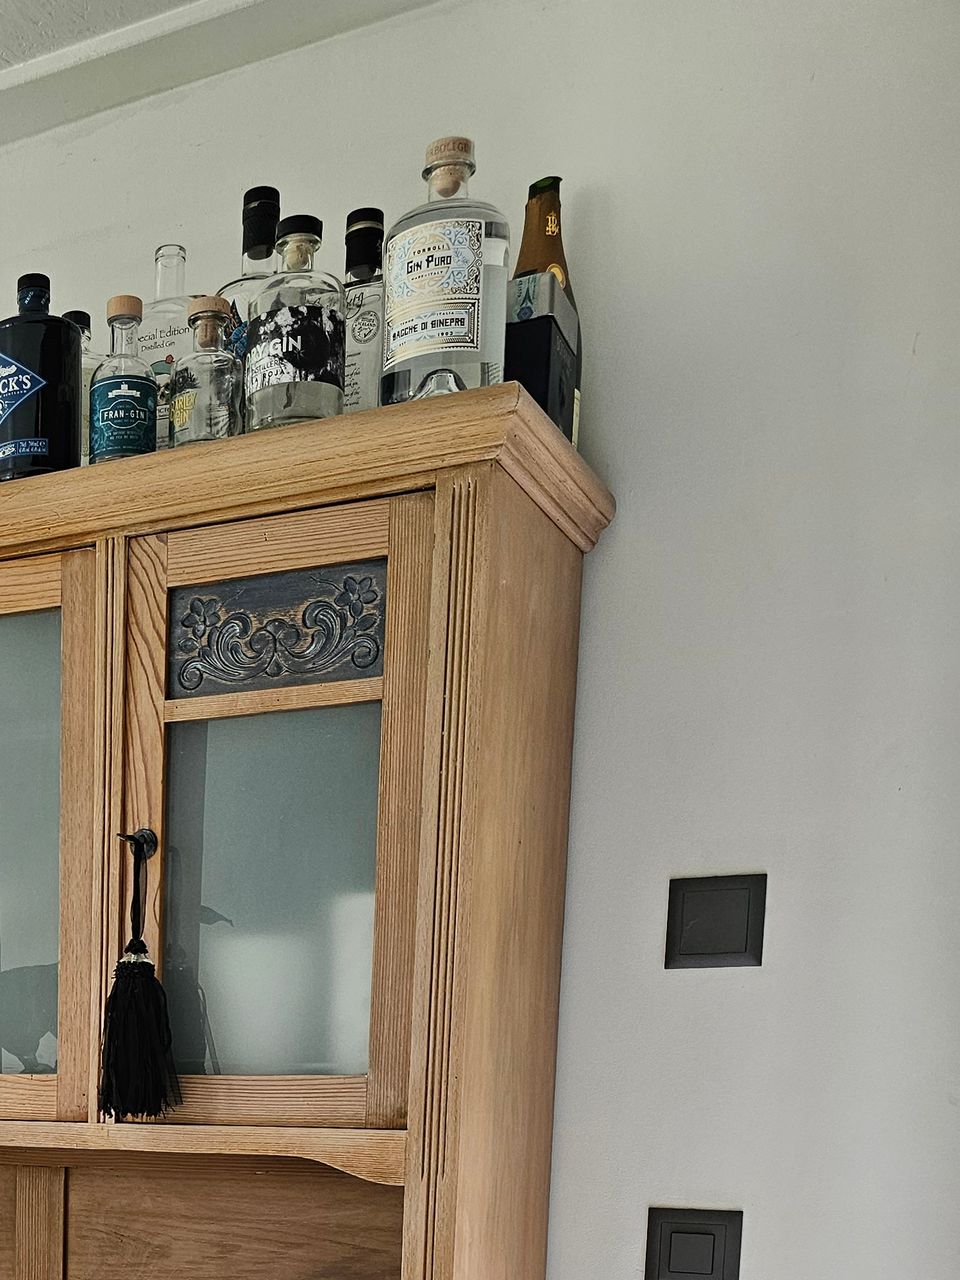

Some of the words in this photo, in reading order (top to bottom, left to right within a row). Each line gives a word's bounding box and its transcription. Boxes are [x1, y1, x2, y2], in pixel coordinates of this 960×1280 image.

[137, 328, 158, 343] ecial
[159, 325, 190, 339] Edition
[269, 335, 302, 358] GIN
[103, 409, 146, 421] FRAN-GIN
